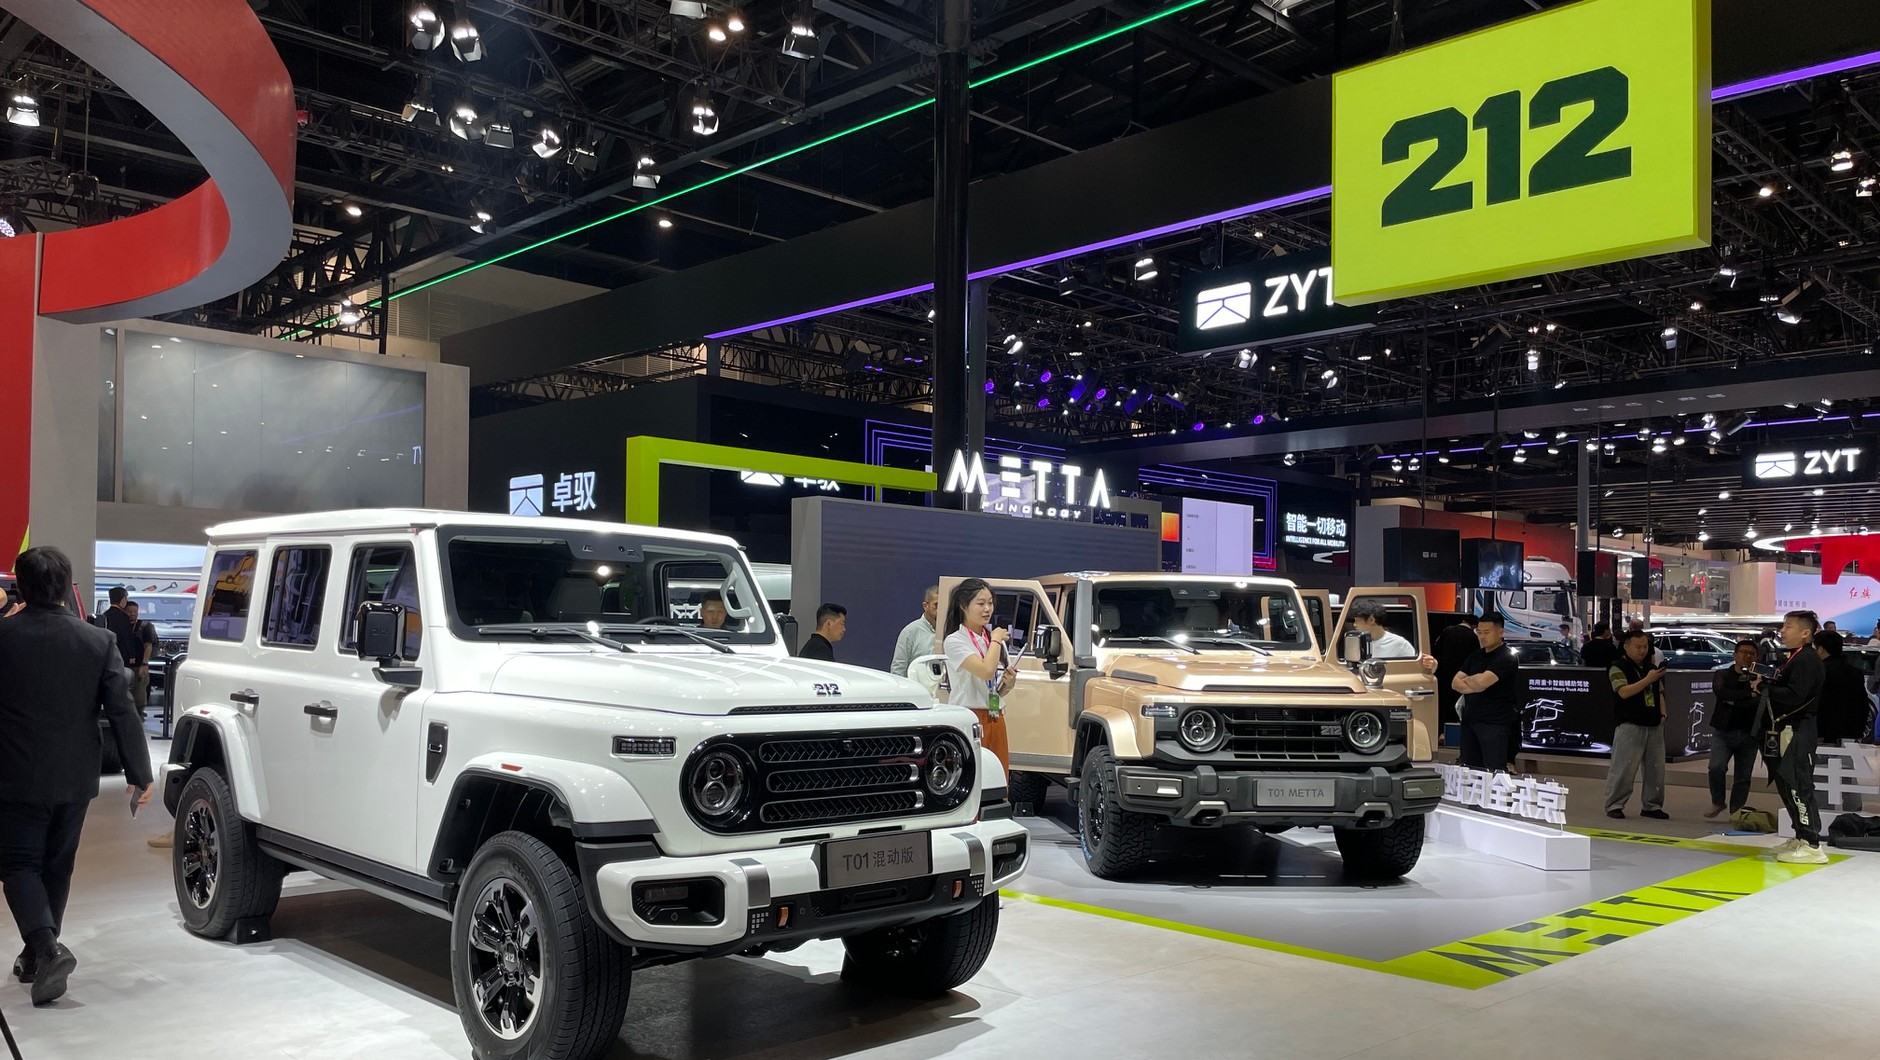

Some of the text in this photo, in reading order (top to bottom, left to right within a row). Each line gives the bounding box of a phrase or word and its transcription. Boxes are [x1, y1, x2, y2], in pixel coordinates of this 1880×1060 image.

[1381, 65, 1632, 229] 212
[1803, 447, 1862, 475] ZYT
[943, 448, 1111, 509] METTA
[551, 471, 597, 513] 卓驭
[1286, 512, 1347, 537] 智能一切移动
[1849, 586, 1871, 599] 红旗
[813, 683, 842, 697] 212
[1320, 725, 1343, 736] 212
[1267, 788, 1325, 798] T01 METTA
[842, 846, 914, 872] T01 混动版
[1426, 885, 1752, 978] METTA
[504, 952, 515, 963] 212
